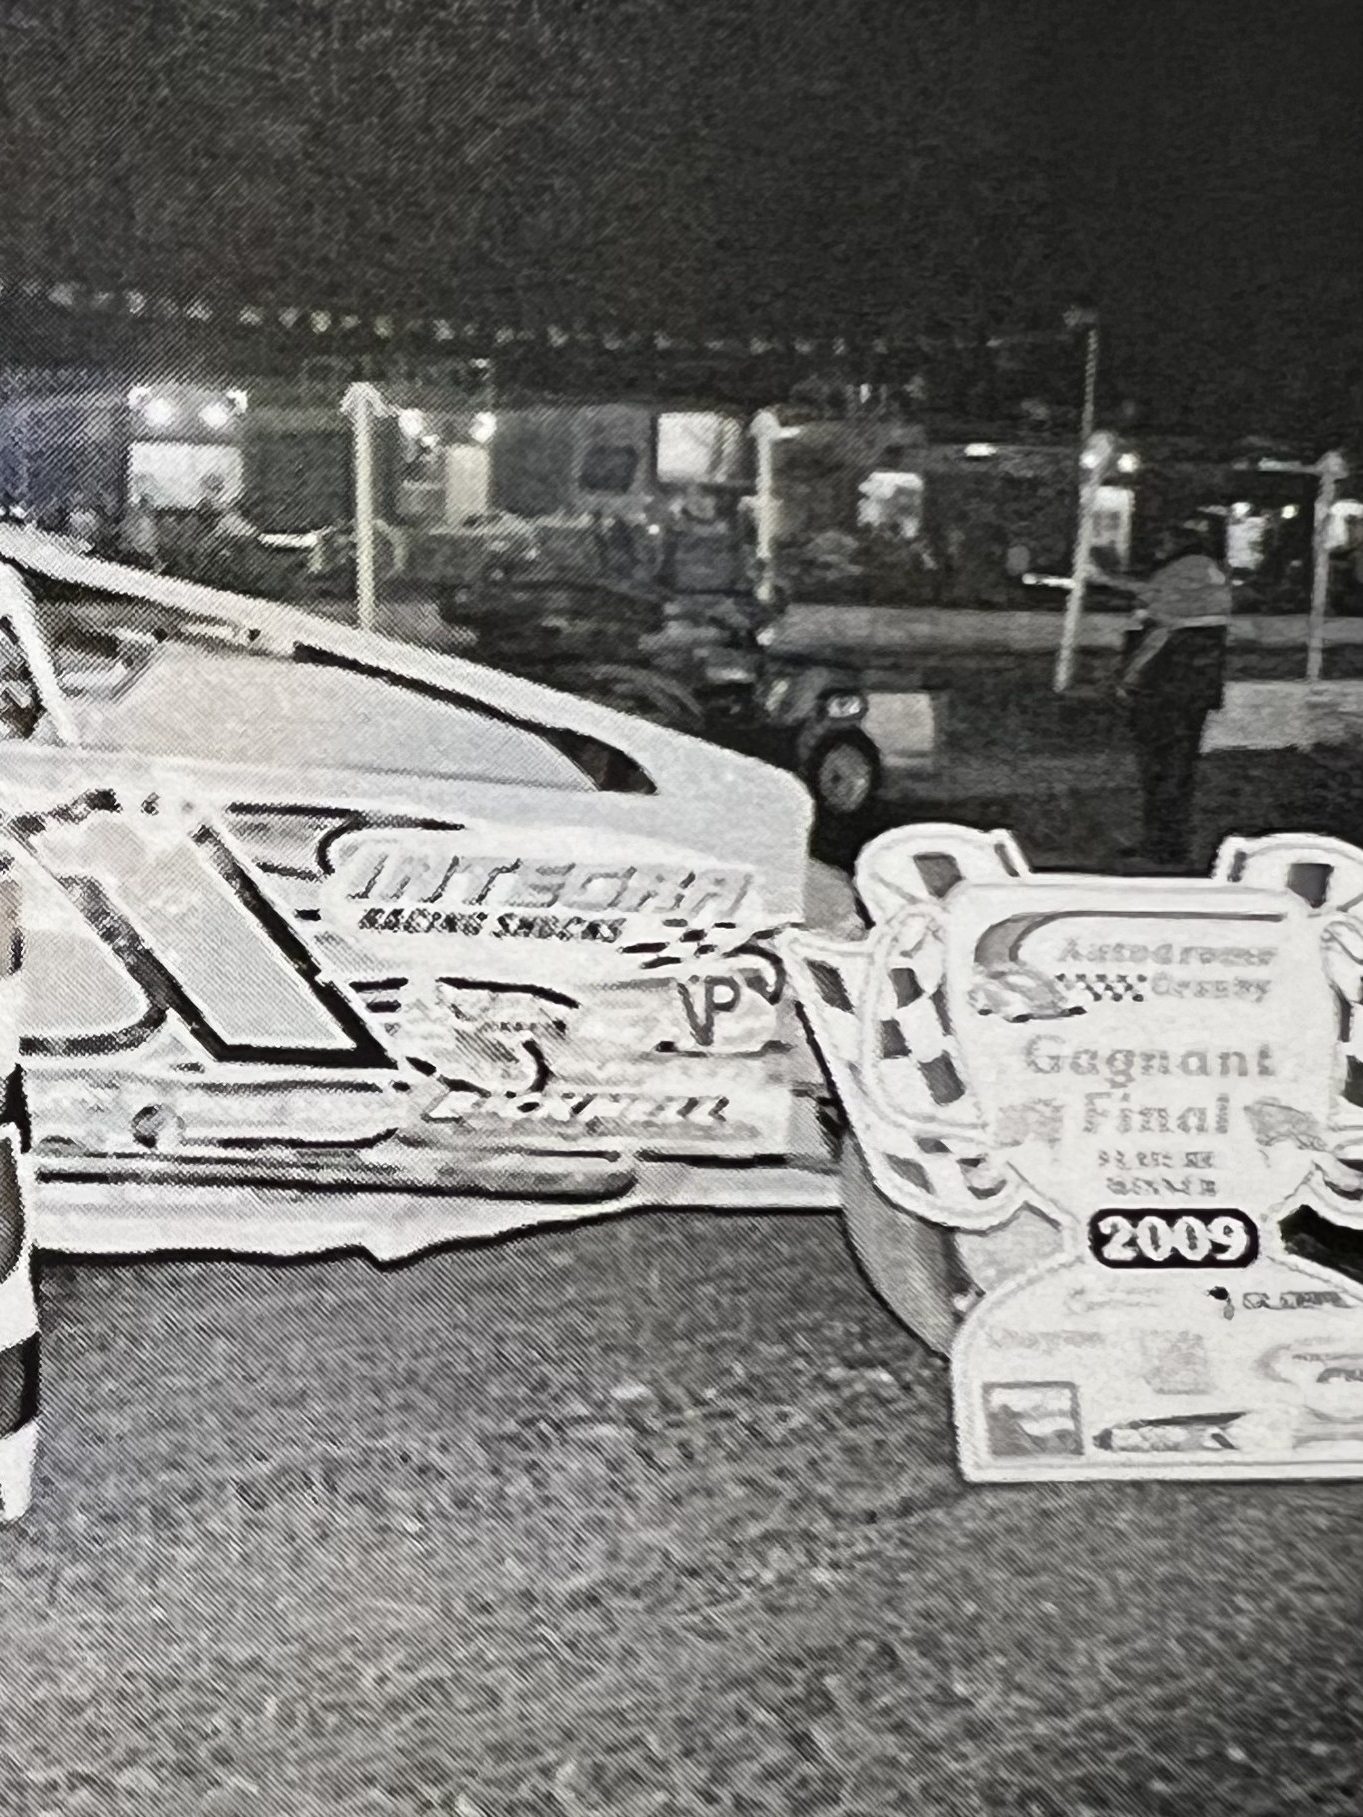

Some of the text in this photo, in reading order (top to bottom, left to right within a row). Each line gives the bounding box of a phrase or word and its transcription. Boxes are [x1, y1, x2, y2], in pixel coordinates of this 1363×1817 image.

[358, 906, 627, 943] RACING SHOCKS
[676, 973, 742, 1047] VP
[1023, 1033, 1277, 1089] Gagnant
[1081, 1088, 1231, 1135] Final
[1097, 1214, 1249, 1262] 2009
